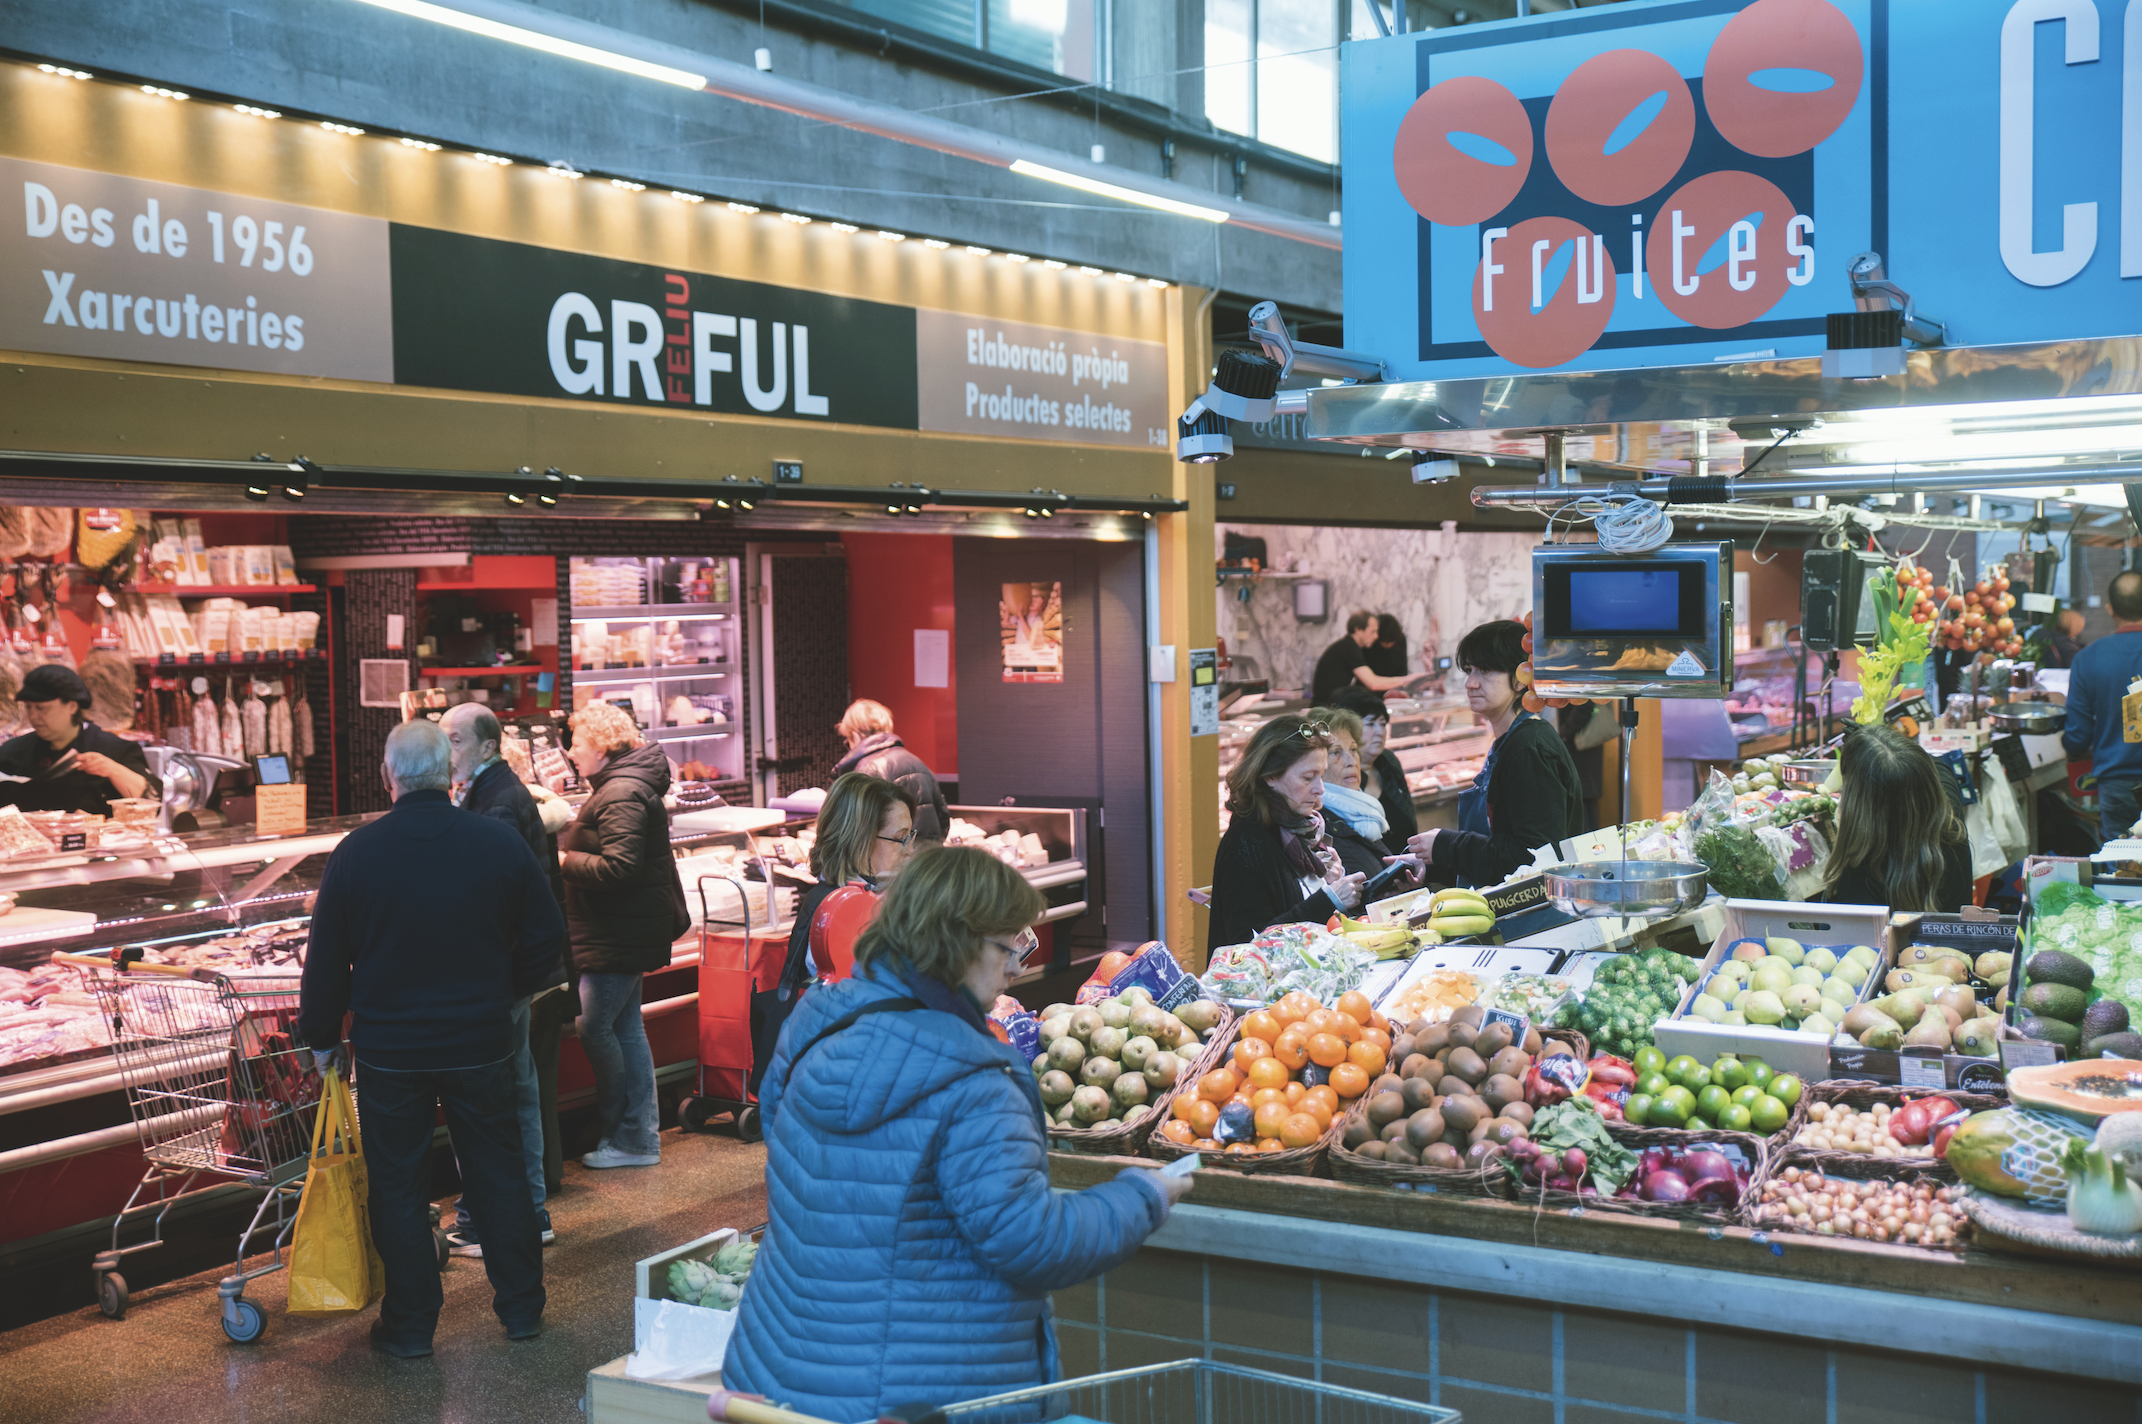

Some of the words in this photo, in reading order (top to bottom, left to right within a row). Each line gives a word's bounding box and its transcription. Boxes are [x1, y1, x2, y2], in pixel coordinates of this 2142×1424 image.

[24, 181, 116, 249] Des
[132, 197, 189, 258] de
[206, 210, 314, 277] 1956
[1482, 209, 1815, 312] Fruites
[41, 269, 305, 352] Xarcuteries
[665, 273, 691, 403] FELIU
[967, 328, 1067, 375] Elaboració
[1073, 346, 1129, 389] pròpia
[967, 382, 1060, 426] Productes
[1064, 393, 1131, 432] selectes
[779, 465, 801, 479] 1-39
[1671, 665, 1700, 673] MINERVA
[1489, 881, 1547, 912] PUIGCERDÀ
[2032, 866, 2053, 877] TROPS
[1921, 924, 1951, 934] PERAS
[1953, 925, 1965, 934] DE
[1966, 924, 2002, 935] RINCÓN
[2003, 926, 2015, 936] DE
